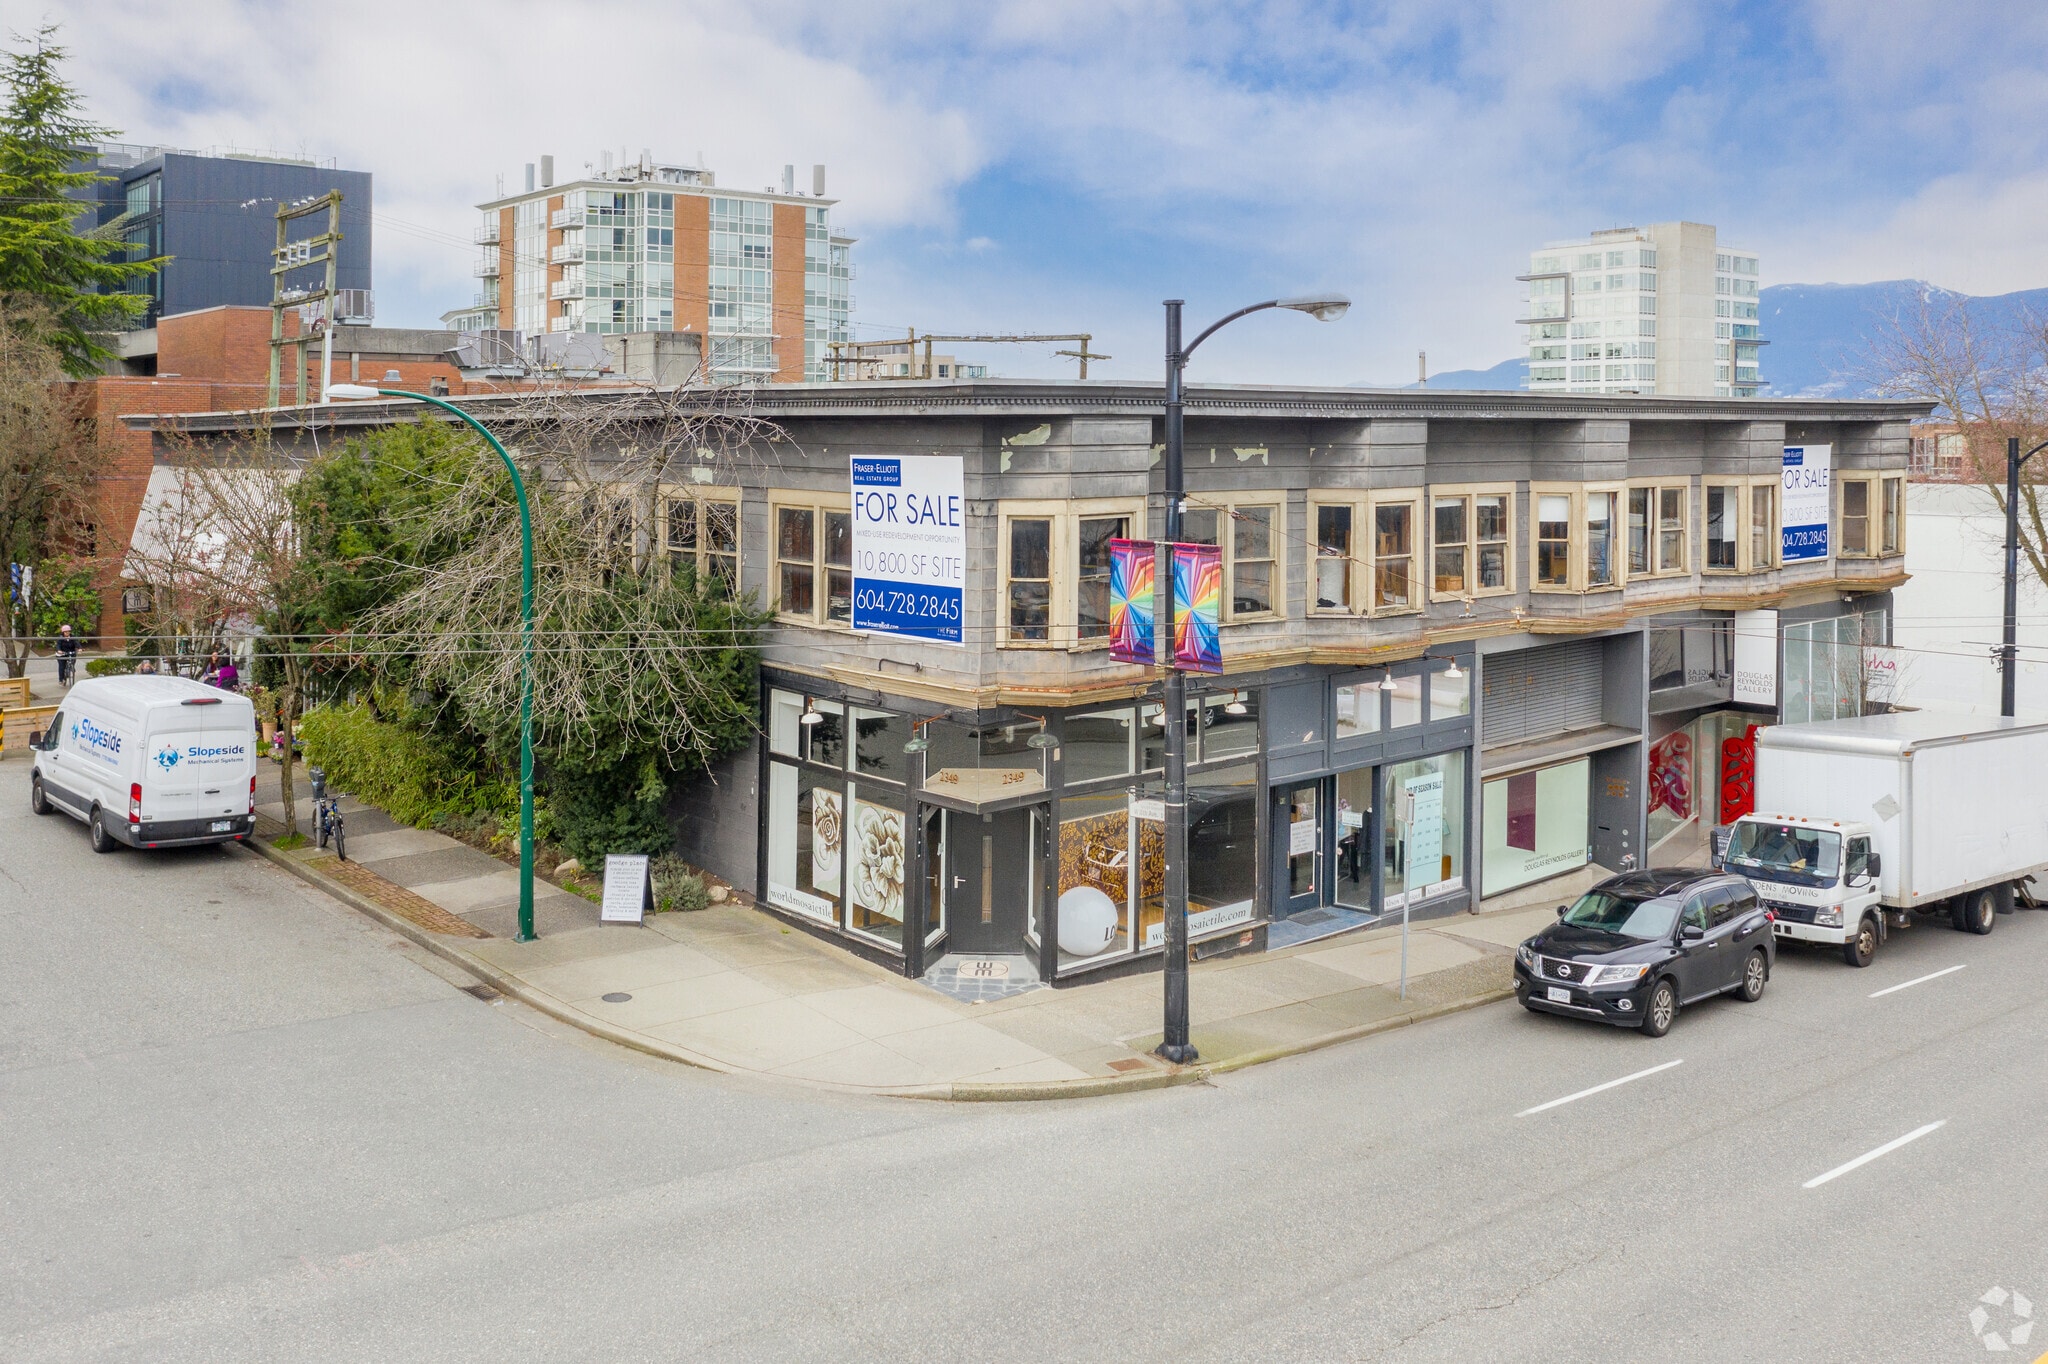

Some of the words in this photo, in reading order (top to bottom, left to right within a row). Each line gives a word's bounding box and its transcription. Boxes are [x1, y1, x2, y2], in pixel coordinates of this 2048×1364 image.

[1782, 469, 1801, 489] OR
[1804, 468, 1828, 488] SALE
[855, 491, 898, 523] FOR
[906, 493, 960, 527] SALE
[1782, 529, 1827, 548] 04.728.2845
[857, 549, 907, 575] 10,800
[911, 554, 927, 576] SF
[932, 556, 961, 579] SITE
[856, 588, 959, 621] 604.728.2845
[1737, 671, 1773, 681] DOUGLAS
[1737, 678, 1774, 687] REYNOLDS
[1737, 685, 1773, 694] GALLERY
[80, 718, 121, 753] Slopeside
[188, 745, 245, 757] Slopeside
[1782, 886, 1819, 898] MOVING
[770, 890, 832, 918] worldmosaictile
[1152, 909, 1247, 941] woosaictile.com
